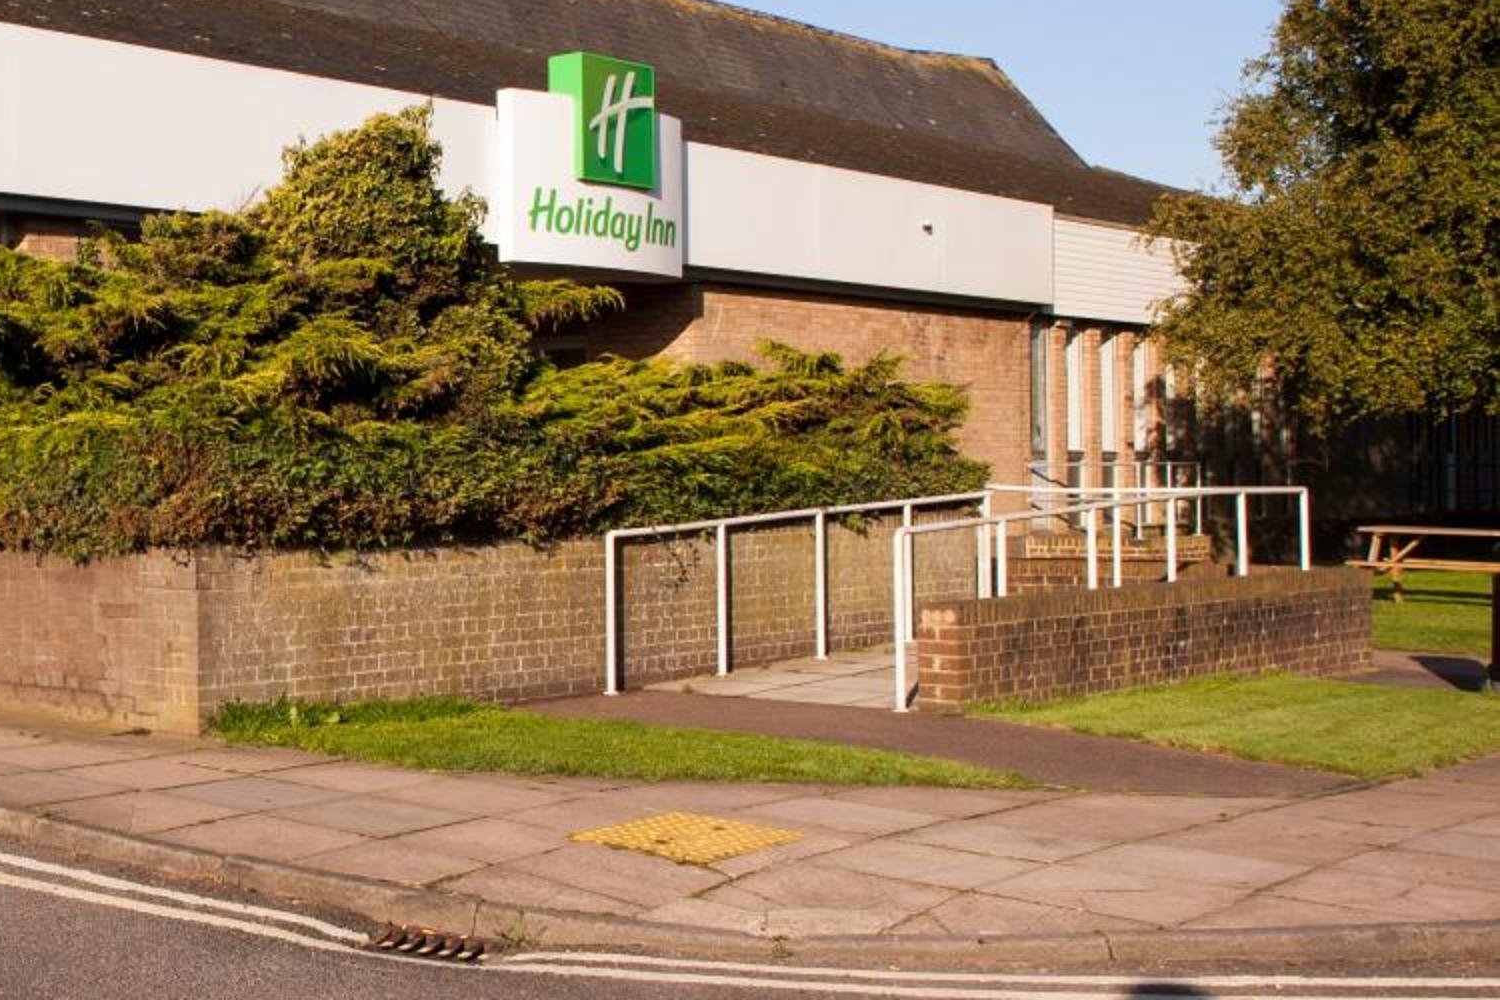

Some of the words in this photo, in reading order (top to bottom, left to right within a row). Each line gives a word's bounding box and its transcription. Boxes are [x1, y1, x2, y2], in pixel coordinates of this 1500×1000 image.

[589, 71, 654, 174] H
[529, 187, 642, 252] Holiday
[646, 202, 676, 248] Inn
